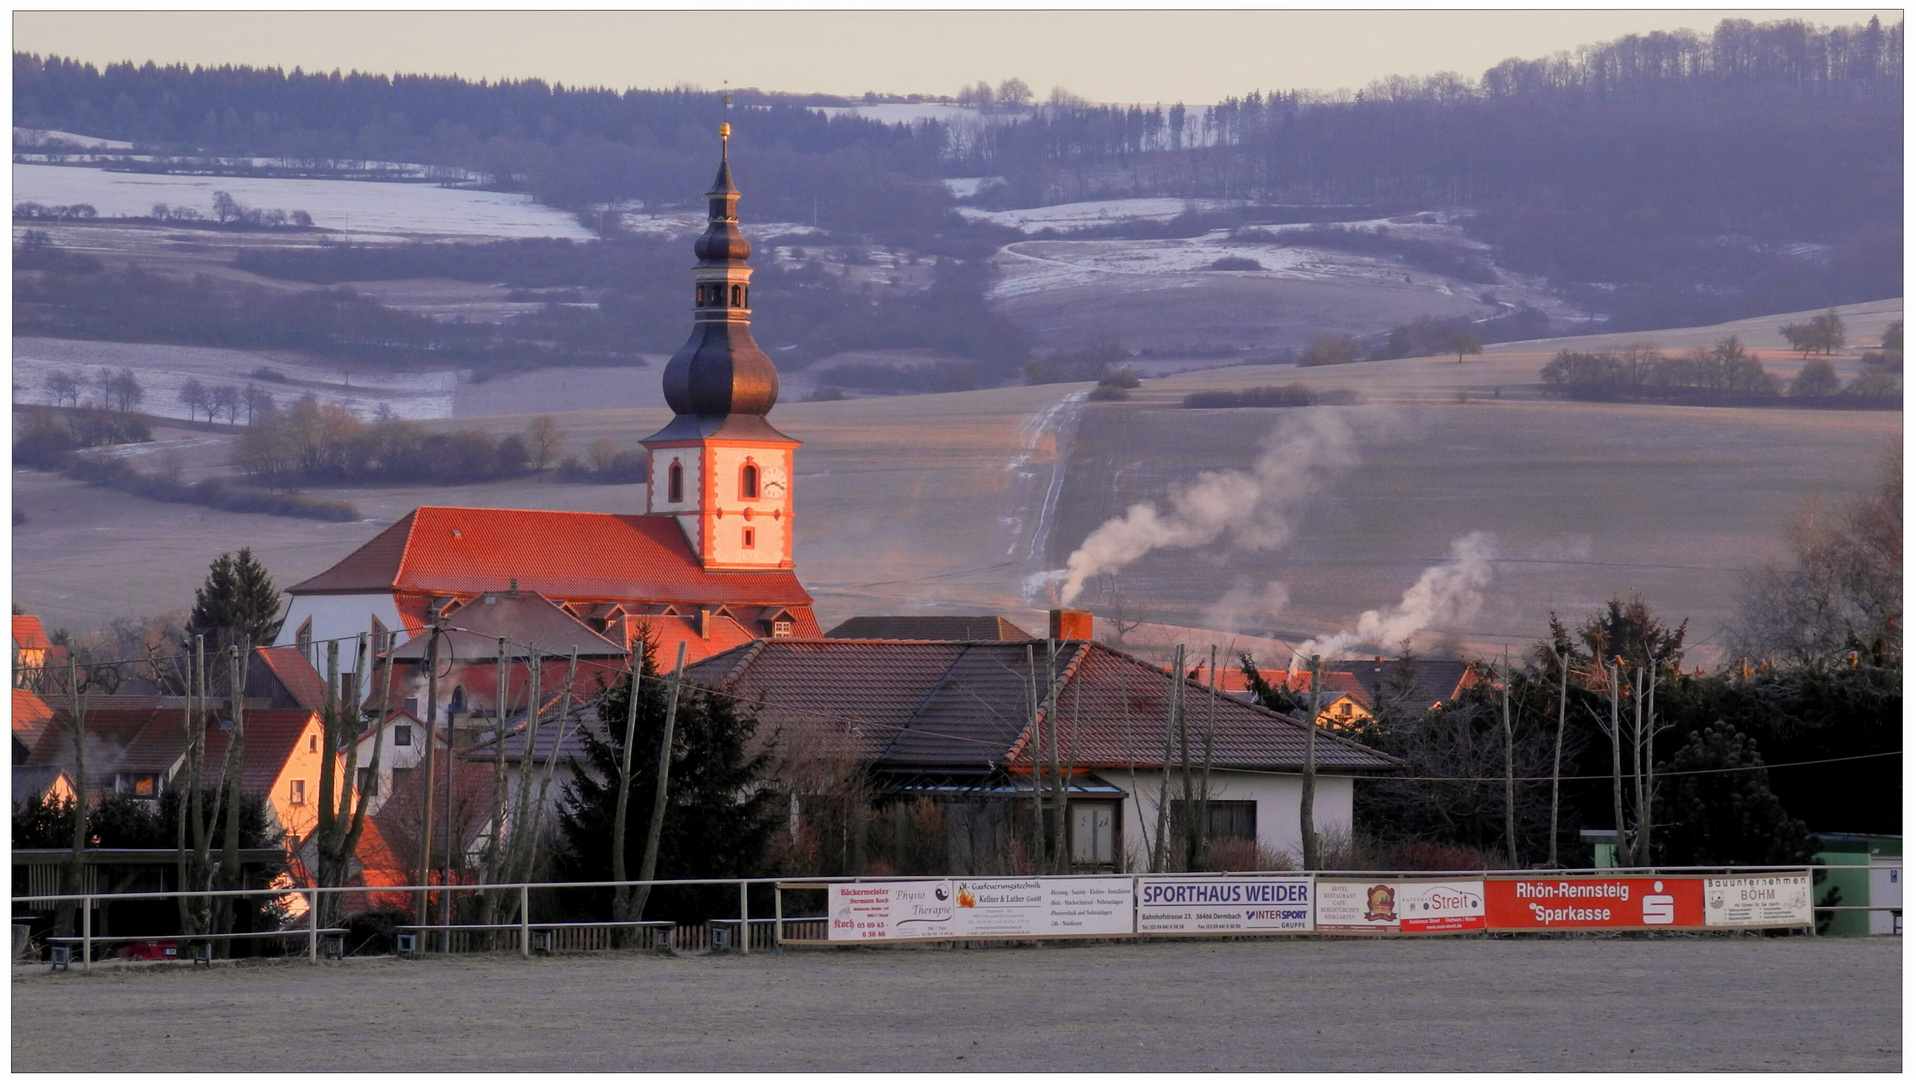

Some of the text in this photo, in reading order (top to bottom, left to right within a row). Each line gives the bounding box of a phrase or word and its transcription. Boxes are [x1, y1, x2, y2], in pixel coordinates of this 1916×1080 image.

[972, 881, 1041, 891] Gasfeuerungstechnik
[1708, 877, 1806, 887] Bauunternehmen
[895, 890, 925, 902] Physio
[1143, 885, 1308, 902] SPORTHAUS WEIDER
[1516, 882, 1629, 901] Rhön-Rennsteig
[1741, 886, 1775, 900] BÖHM
[979, 895, 999, 903] Kellner
[1006, 895, 1024, 903] Luther
[1432, 893, 1468, 910] Streit
[912, 904, 951, 917] Therapie
[1214, 912, 1241, 920] Dermbach
[1256, 910, 1307, 919] INTERSPORT
[1535, 905, 1611, 925] Sparkasse
